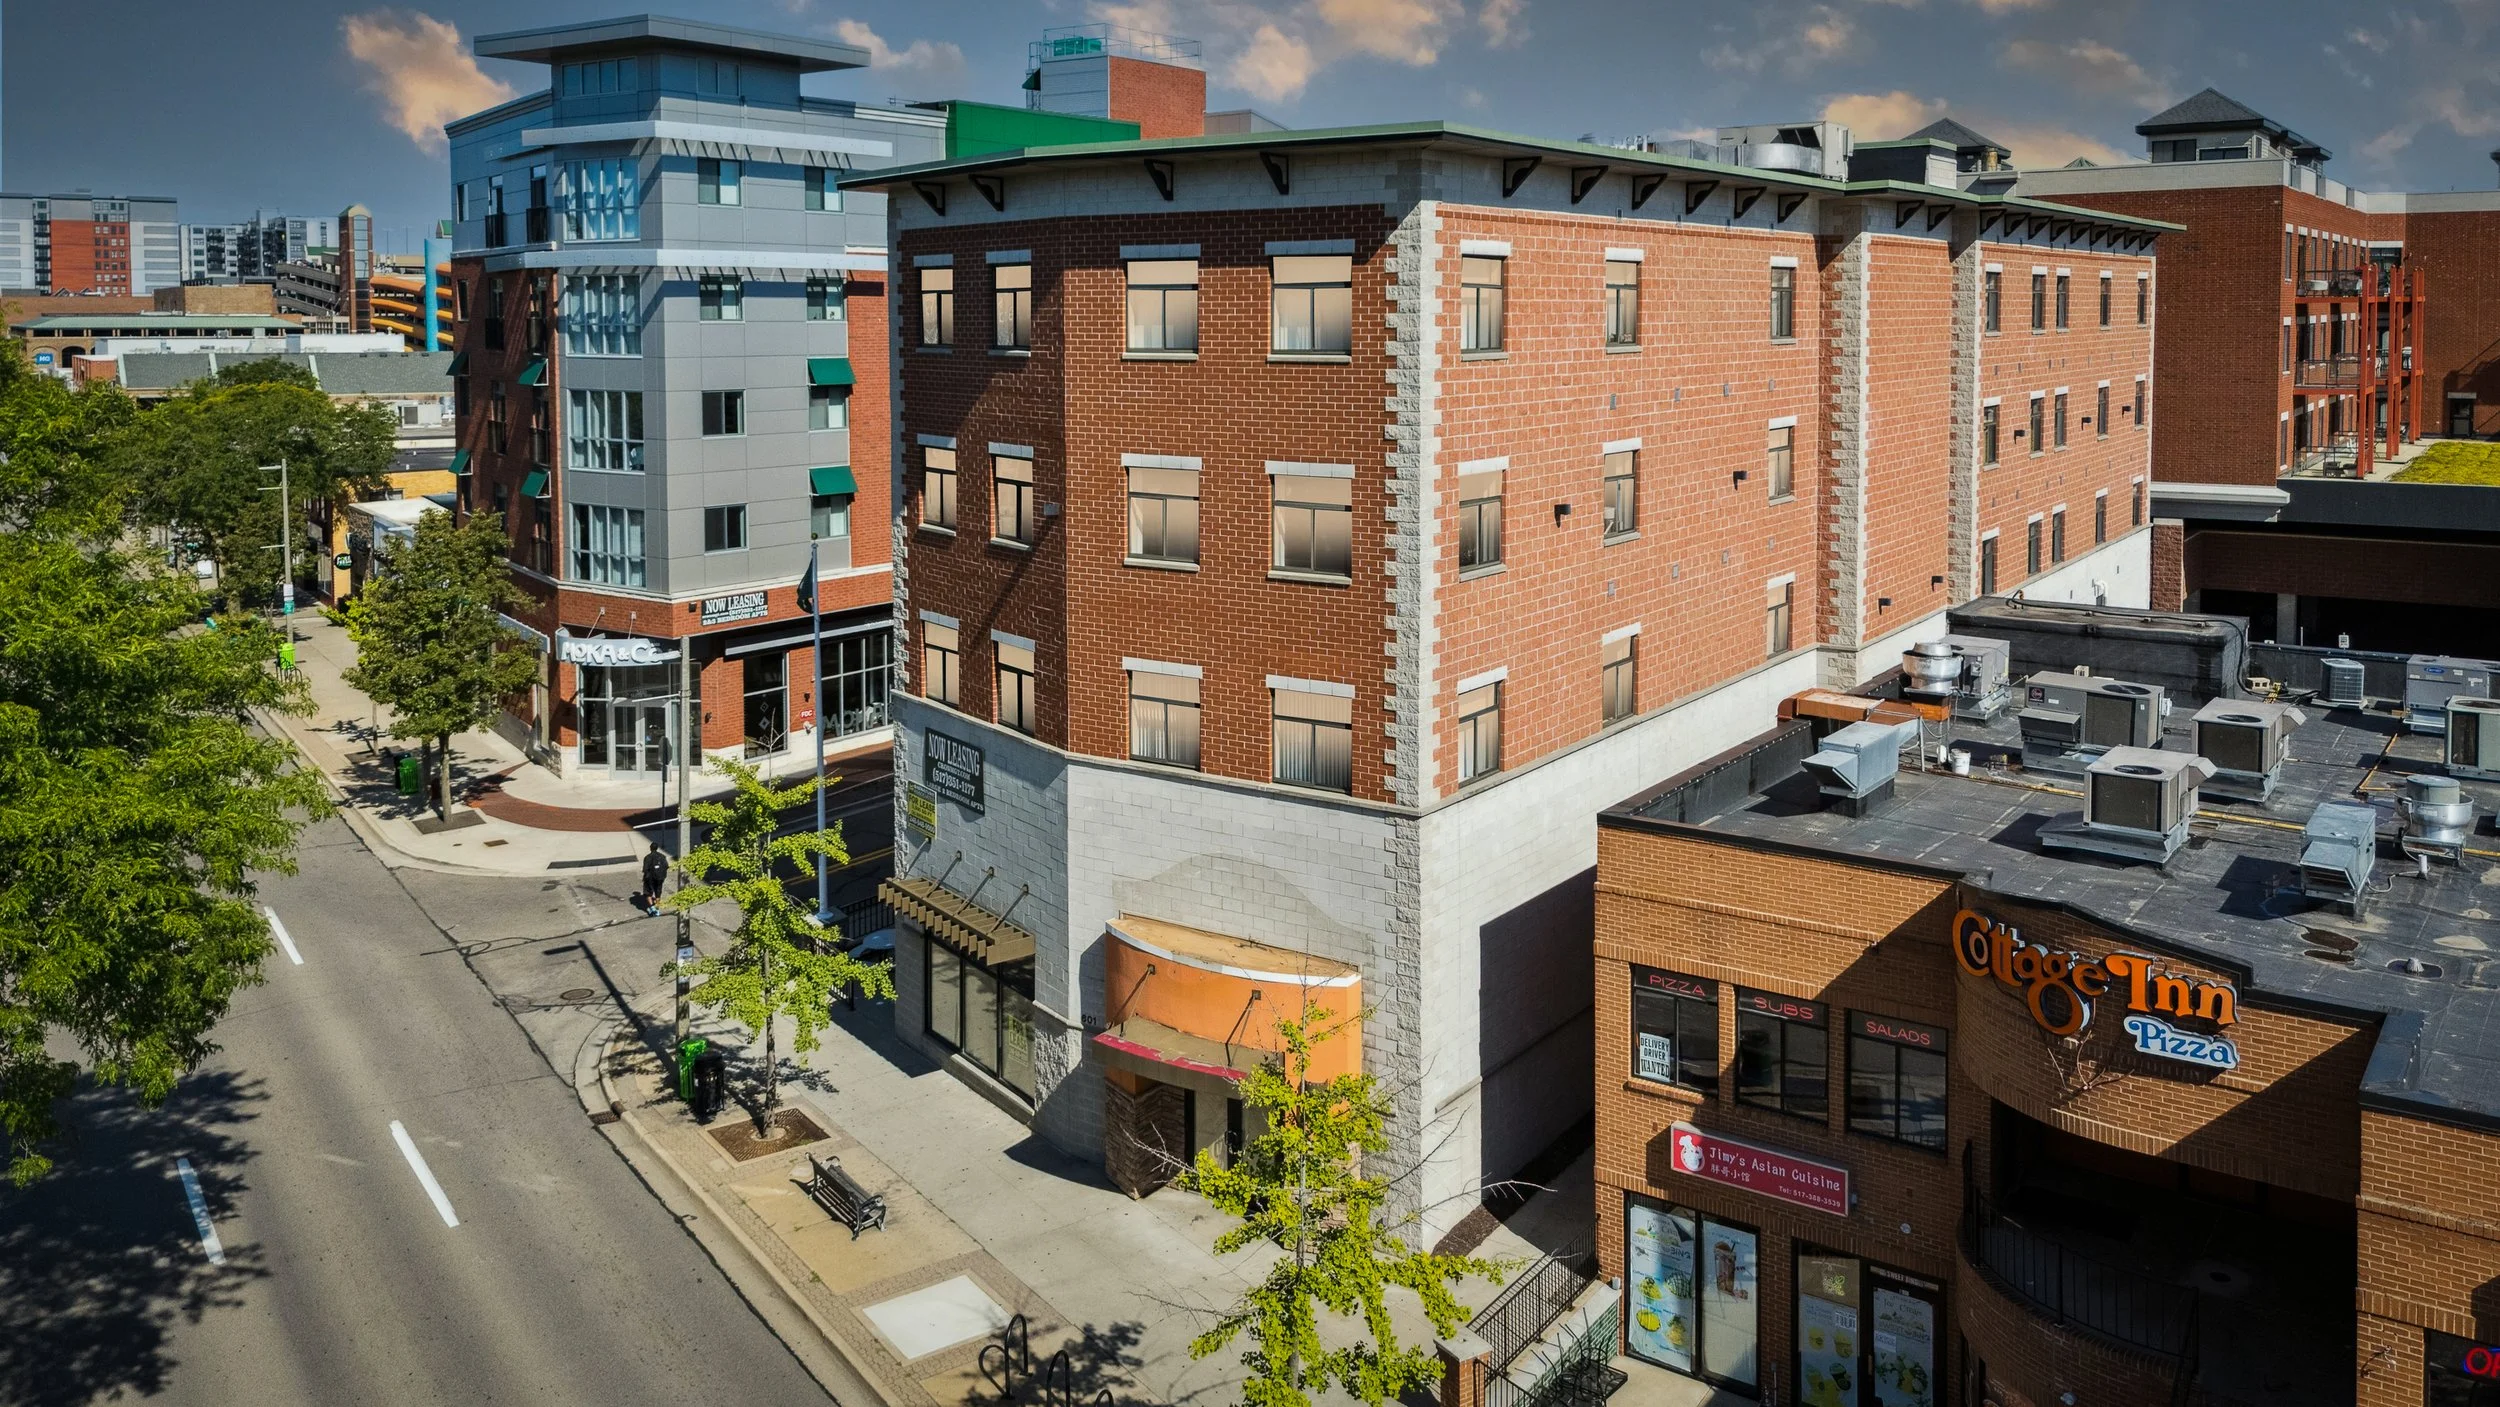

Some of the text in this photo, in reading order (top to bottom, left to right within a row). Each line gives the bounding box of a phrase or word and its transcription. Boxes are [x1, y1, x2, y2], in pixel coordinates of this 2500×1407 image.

[705, 592, 765, 614] NOW LEASING
[561, 642, 617, 665] MOKA
[801, 710, 813, 718] FDC
[928, 733, 980, 776] NOW LEASING
[970, 800, 984, 811] APTS
[1952, 909, 2239, 1035] Cottage Inn
[1649, 974, 1705, 996] PIZZA
[1752, 997, 1814, 1020] SUBS
[1866, 1021, 1931, 1045] SALADS
[2128, 1020, 2232, 1065] Pizza
[1641, 1037, 1669, 1052] DELIVERY
[1644, 1047, 1665, 1061] DRIVER
[1641, 1058, 1670, 1078] WANTED
[1709, 1147, 1840, 1192] Jimy's Asian Cuisine
